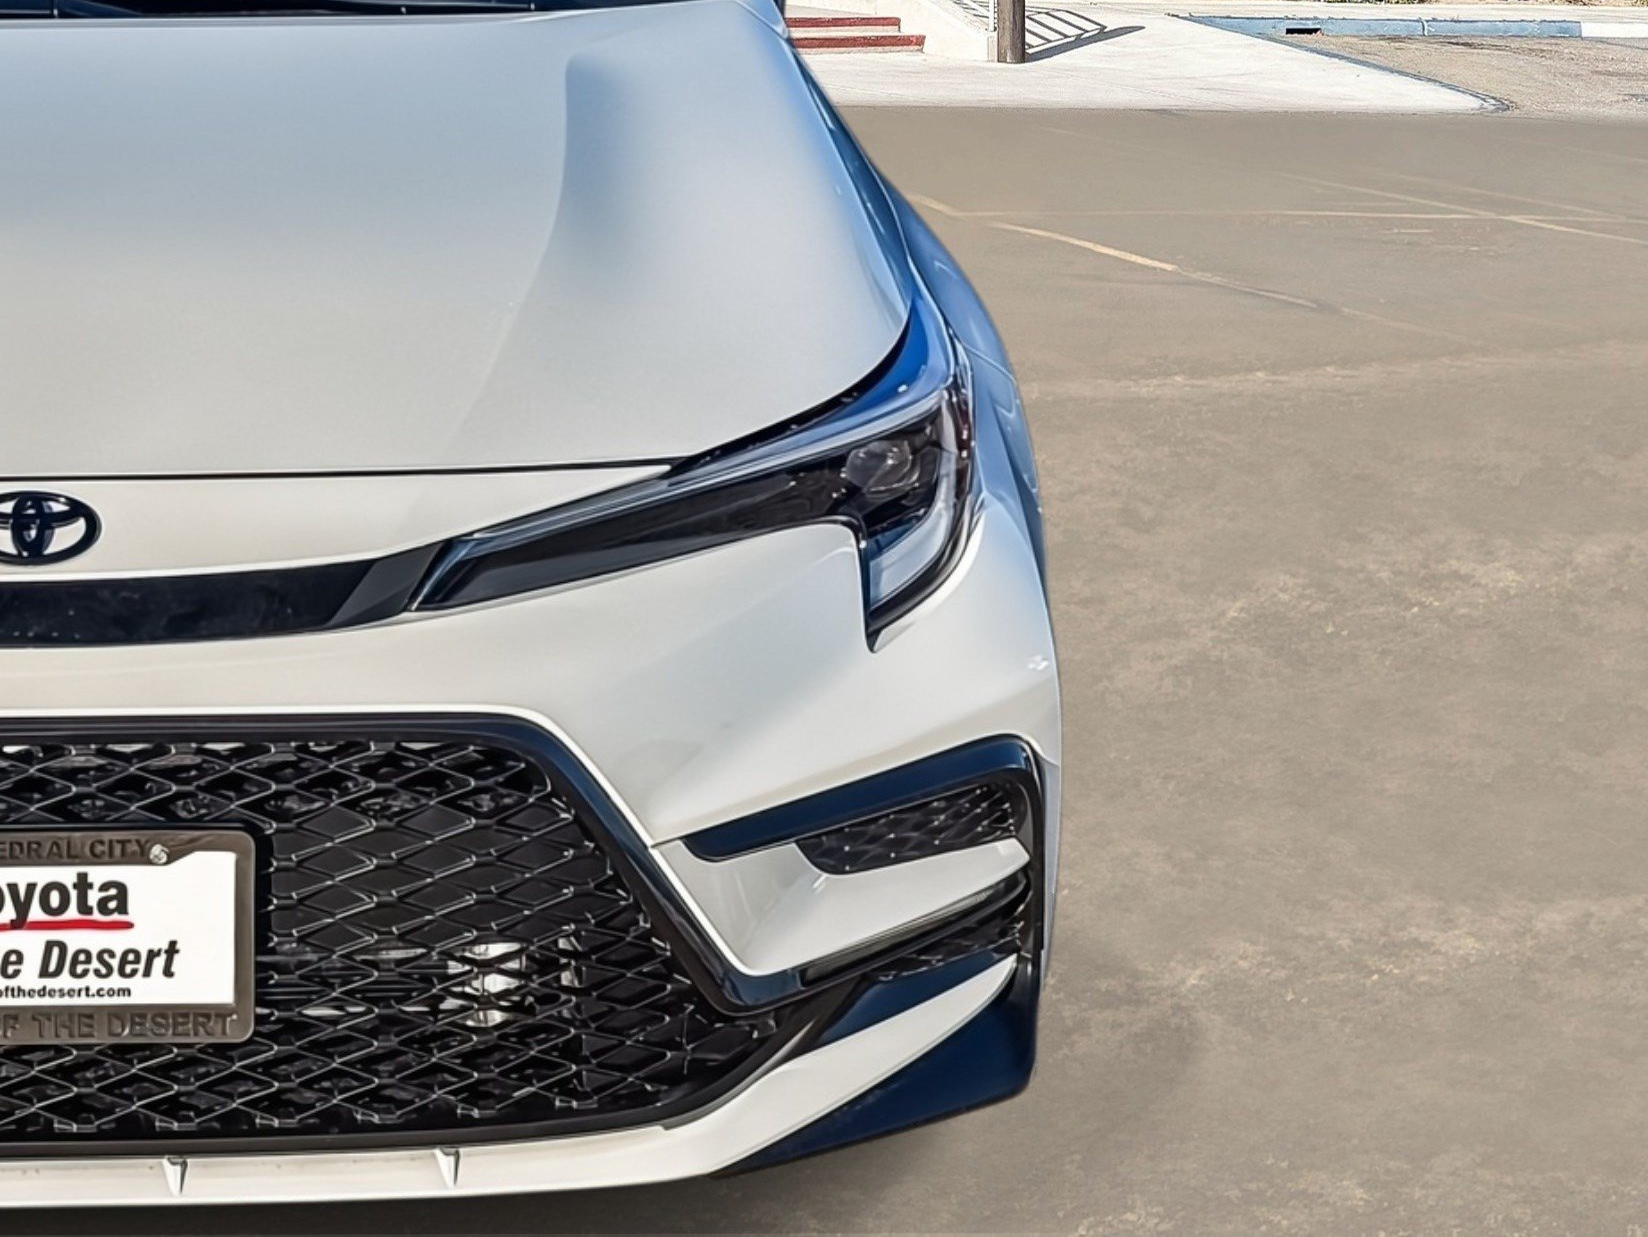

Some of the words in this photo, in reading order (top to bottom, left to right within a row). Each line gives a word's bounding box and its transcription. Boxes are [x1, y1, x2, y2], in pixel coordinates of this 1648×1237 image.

[88, 838, 150, 860] CITY
[38, 939, 181, 979] Desert
[31, 1012, 96, 1039] THE
[107, 1011, 238, 1038] DESERT
